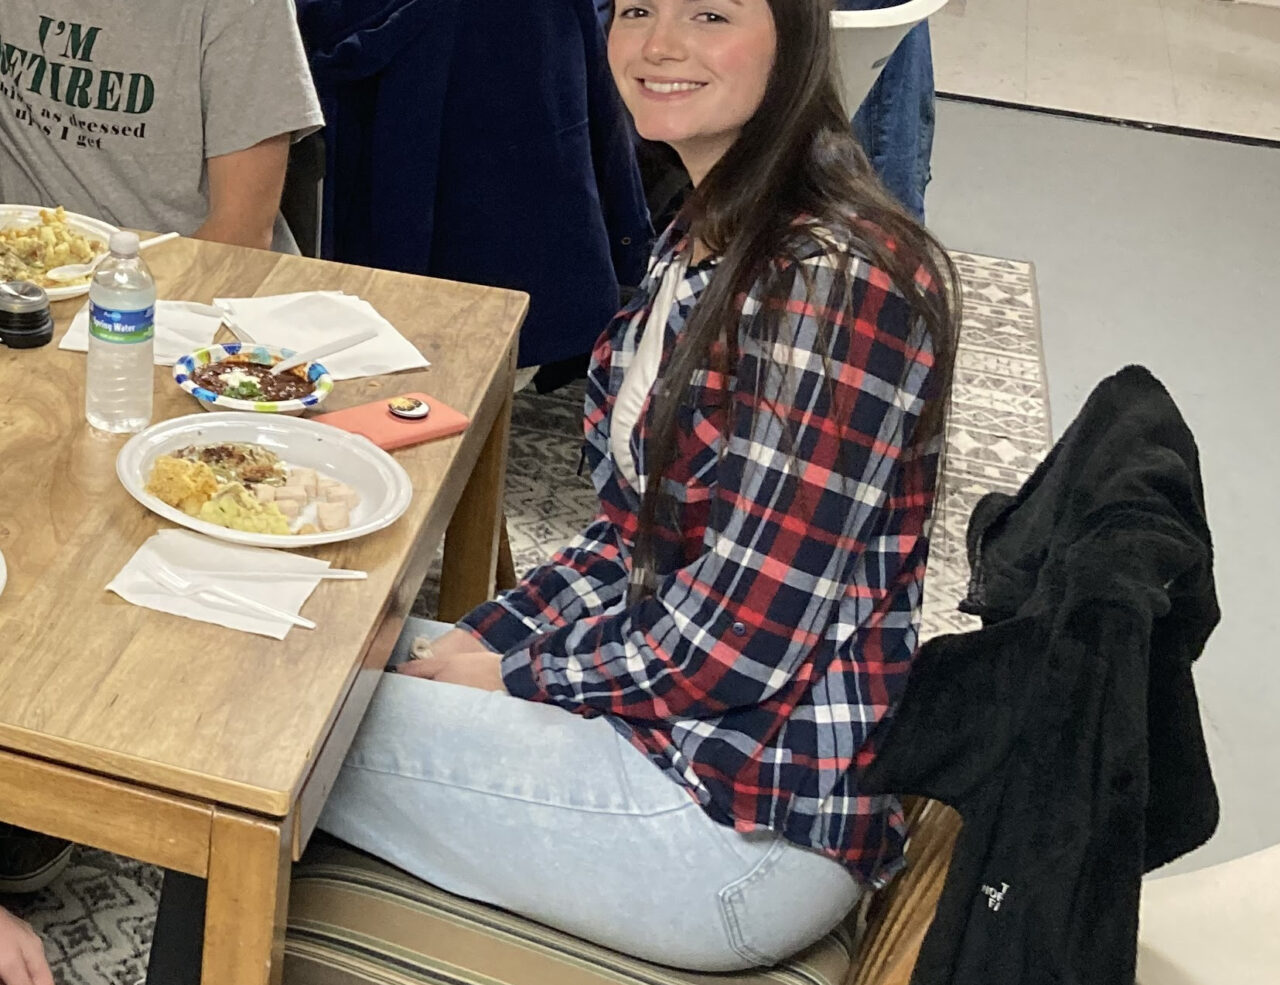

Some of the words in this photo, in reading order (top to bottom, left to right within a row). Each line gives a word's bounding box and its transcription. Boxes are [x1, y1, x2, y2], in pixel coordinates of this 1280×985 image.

[38, 15, 103, 63] I'M
[41, 108, 62, 122] as
[69, 113, 146, 139] dressed
[60, 126, 69, 141] I
[76, 134, 104, 150] get
[93, 315, 112, 332] Spring
[113, 322, 136, 333] Water
